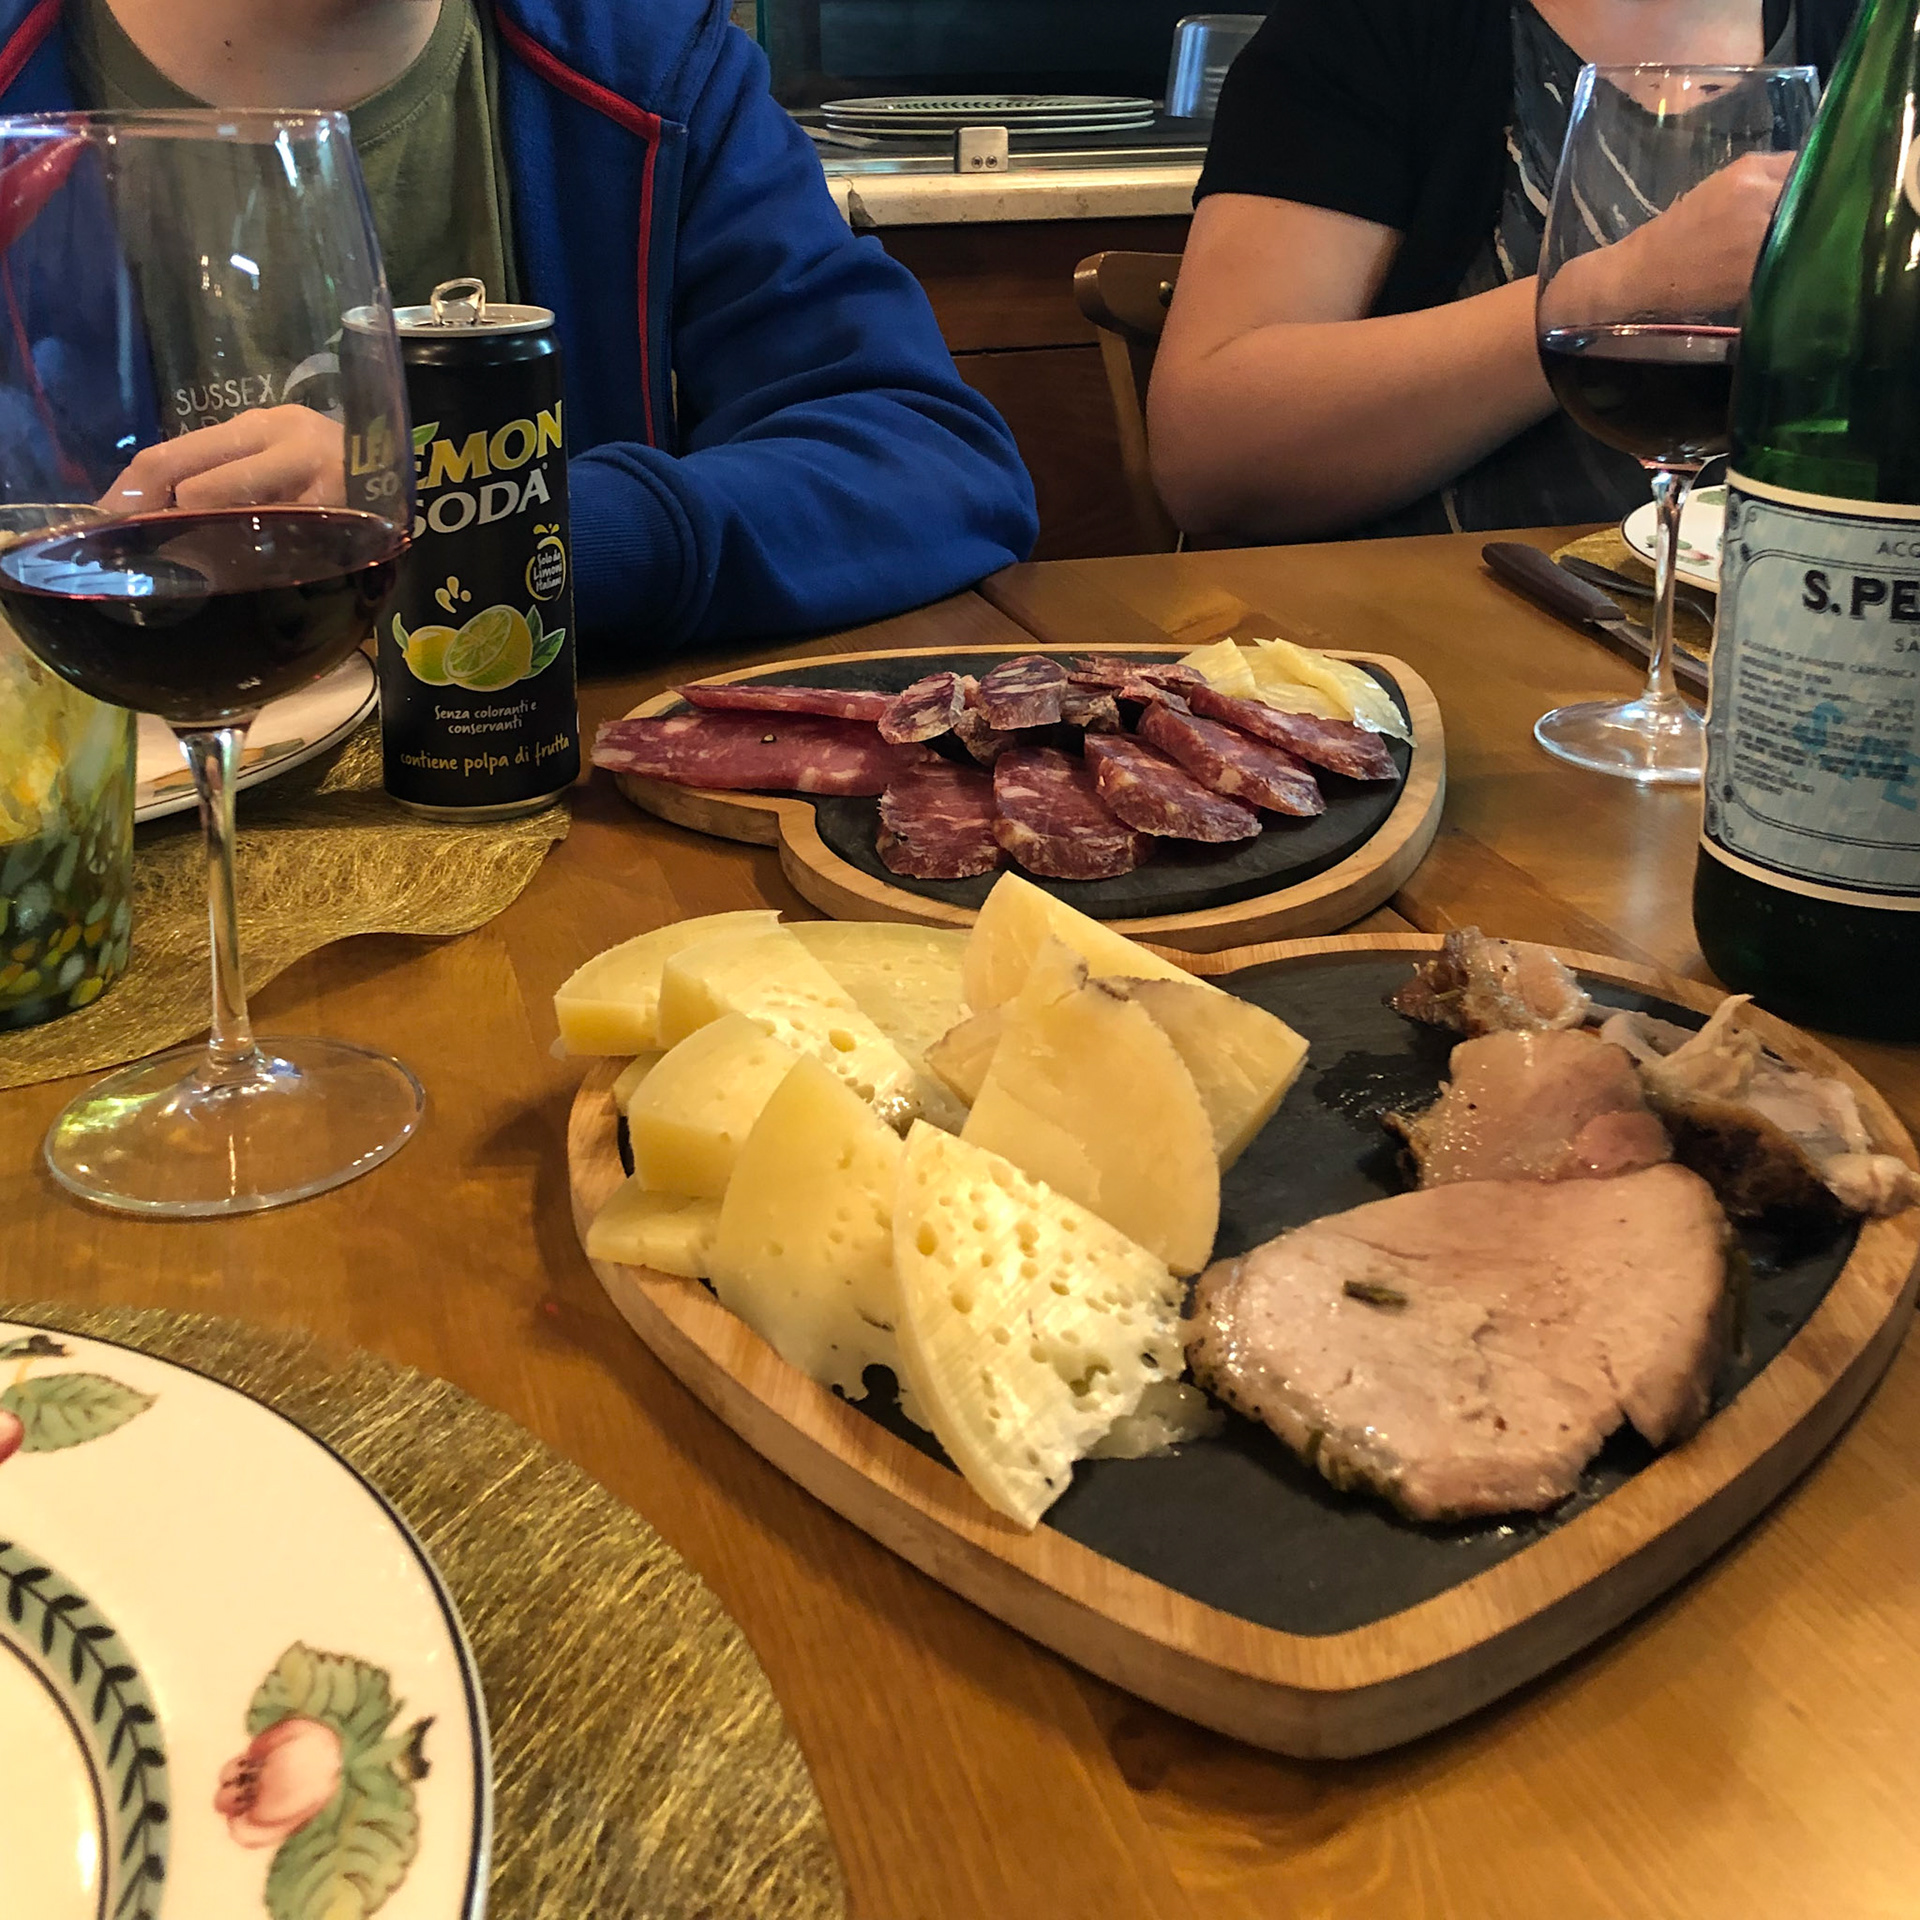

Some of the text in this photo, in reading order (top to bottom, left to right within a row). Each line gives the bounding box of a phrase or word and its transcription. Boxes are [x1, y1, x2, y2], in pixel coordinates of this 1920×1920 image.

[175, 373, 275, 416] SUSSEX
[413, 400, 563, 490] EMON
[1802, 568, 1920, 622] S.PE
[434, 699, 538, 720] Senza coloranti e
[448, 715, 523, 734] conservanti
[400, 732, 570, 777] contiene polpa di frutta
